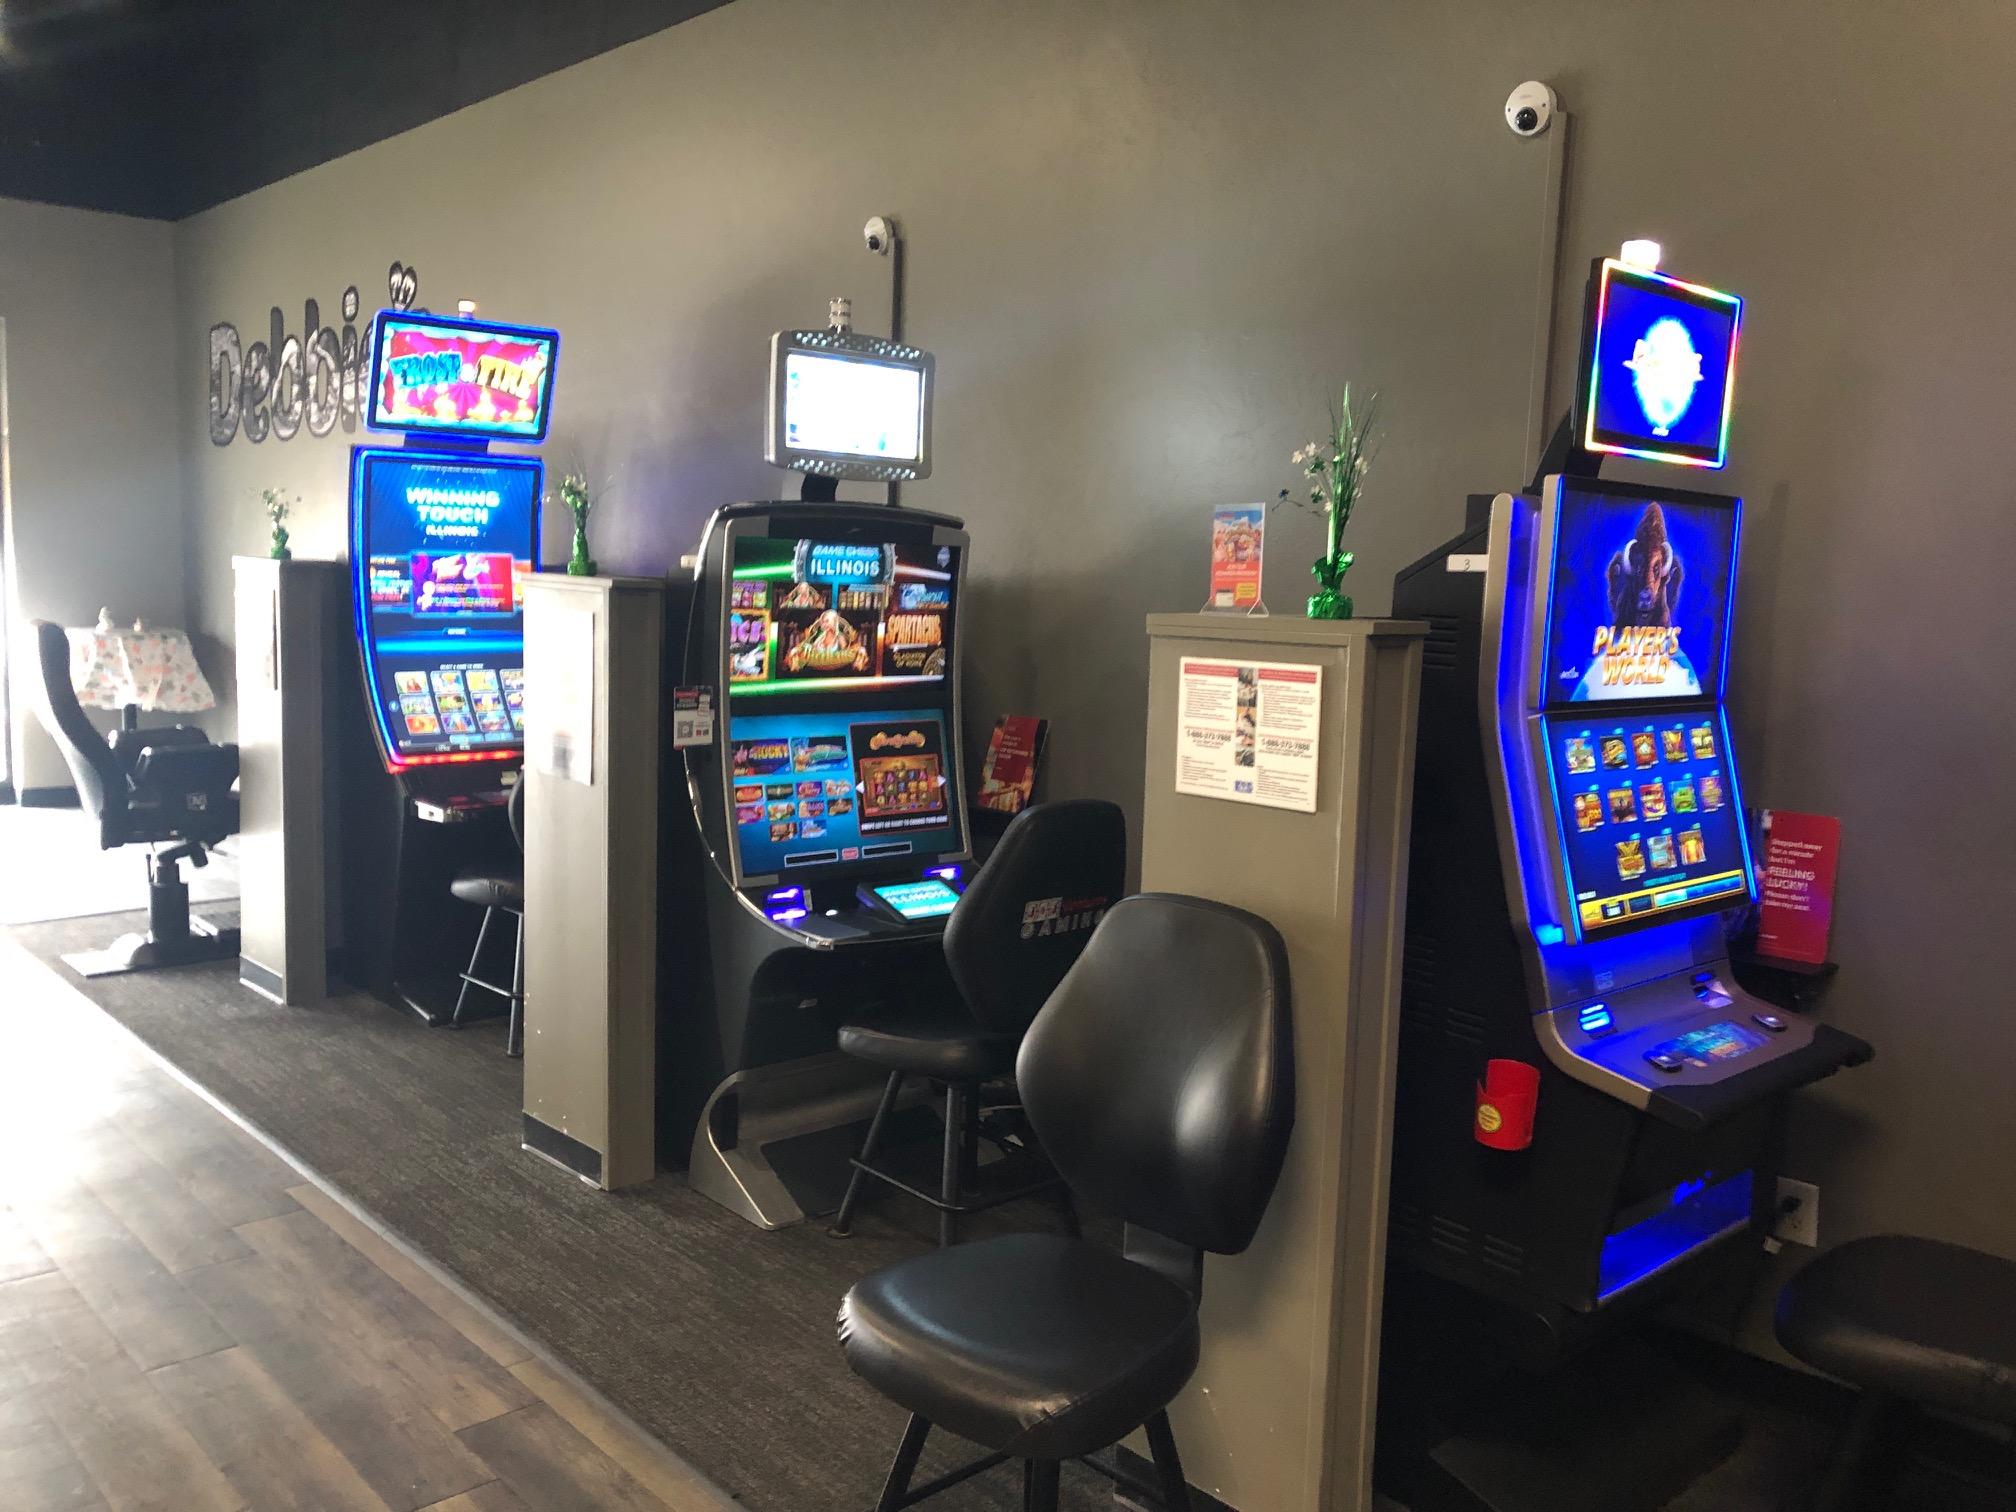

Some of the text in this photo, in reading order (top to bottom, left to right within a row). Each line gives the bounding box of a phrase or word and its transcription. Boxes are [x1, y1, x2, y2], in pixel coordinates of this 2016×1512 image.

[406, 487, 500, 507] WINNING
[417, 504, 489, 524] TOUCH
[812, 544, 846, 556] GAME
[811, 559, 880, 577] ILLINOIS
[1592, 626, 1681, 656] PLAYER'S
[1603, 657, 1671, 686] WORLD
[1769, 866, 1816, 881] FEELING
